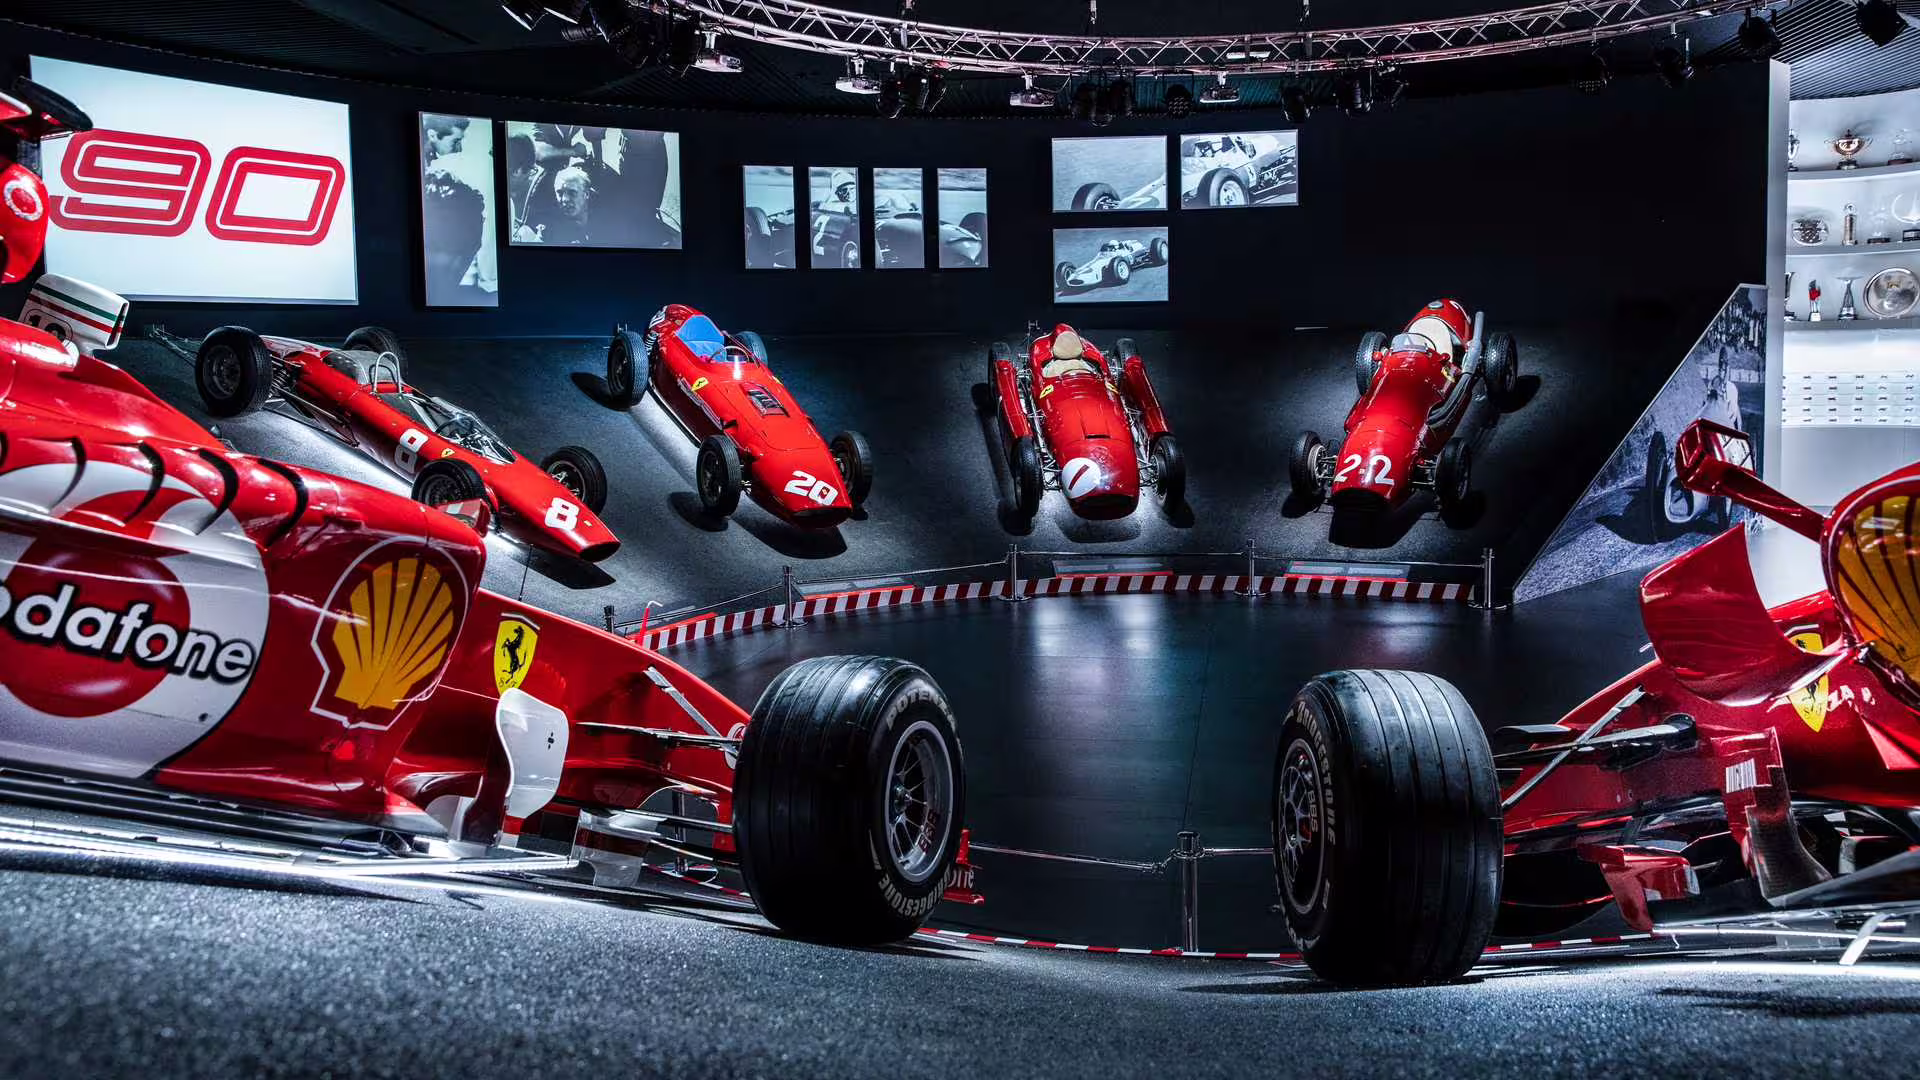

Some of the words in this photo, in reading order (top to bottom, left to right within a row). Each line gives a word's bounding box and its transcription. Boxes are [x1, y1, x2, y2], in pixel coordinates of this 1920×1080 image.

[49, 127, 346, 247] 90
[394, 428, 429, 474] 8
[1333, 453, 1395, 485] 22
[783, 469, 839, 506] 20
[544, 497, 580, 531] 8
[0, 583, 252, 679] dafone
